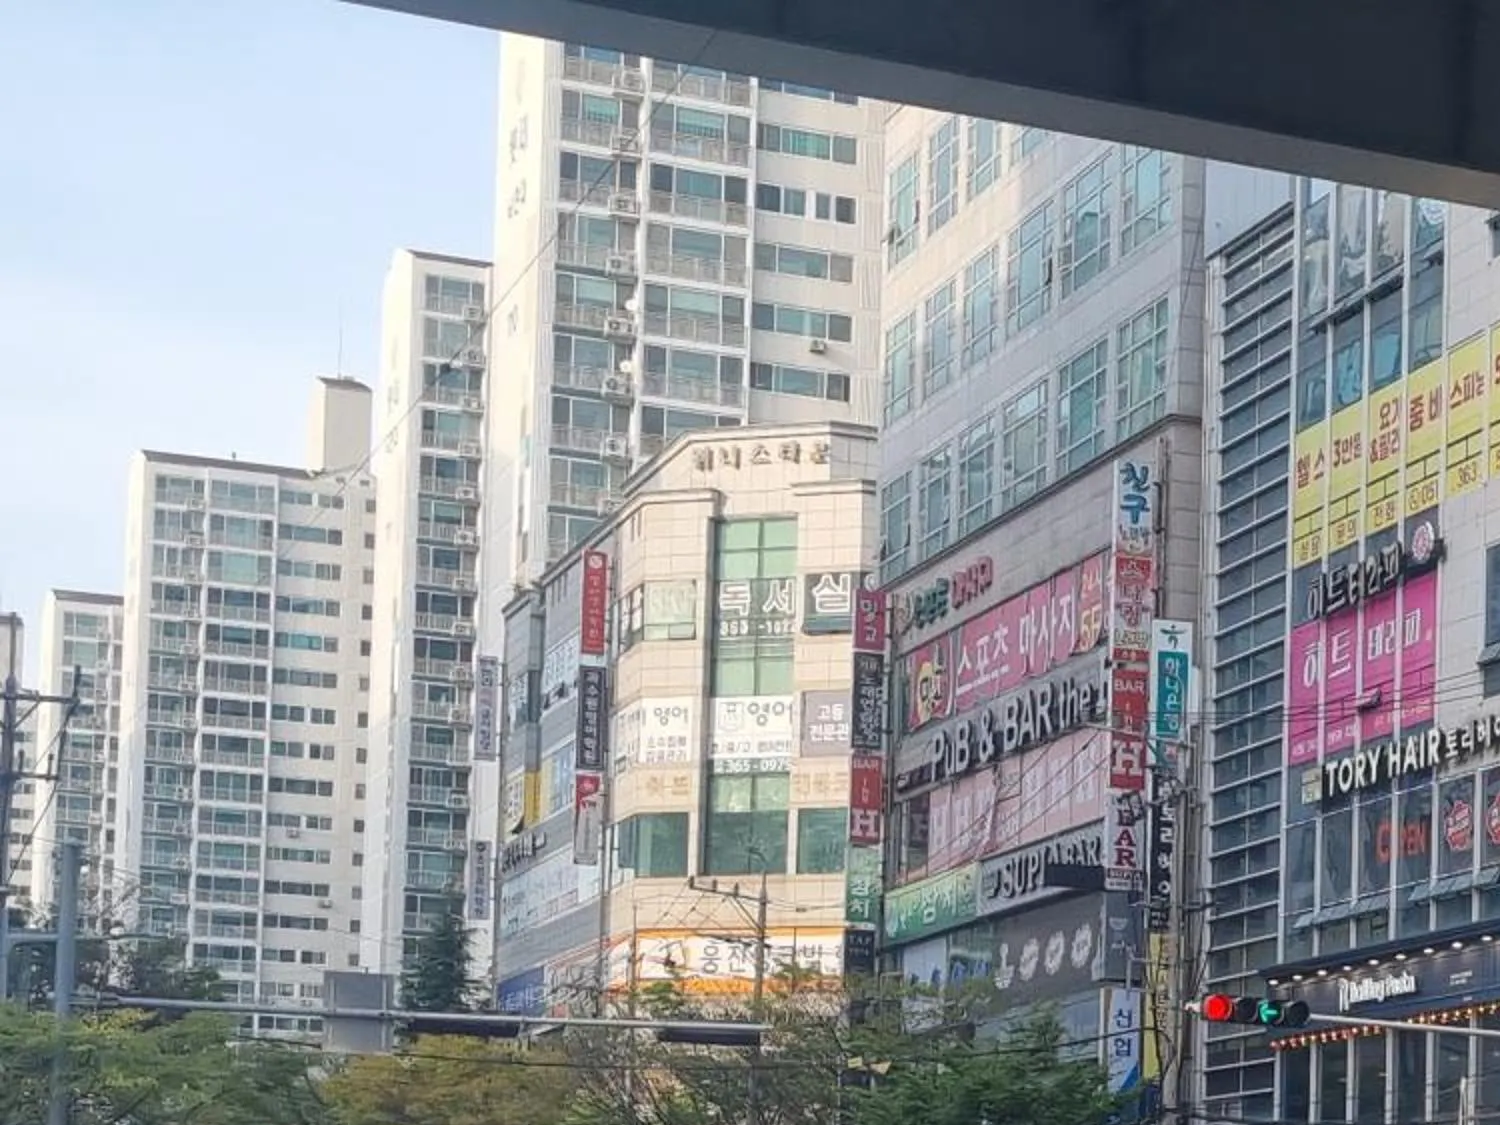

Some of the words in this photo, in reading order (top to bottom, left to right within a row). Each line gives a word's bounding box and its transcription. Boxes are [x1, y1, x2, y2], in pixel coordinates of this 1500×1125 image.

[718, 571, 852, 618] 독서실
[1003, 681, 1053, 749] BAR
[1325, 746, 1384, 798] TORY
[1386, 727, 1442, 778] HAIR
